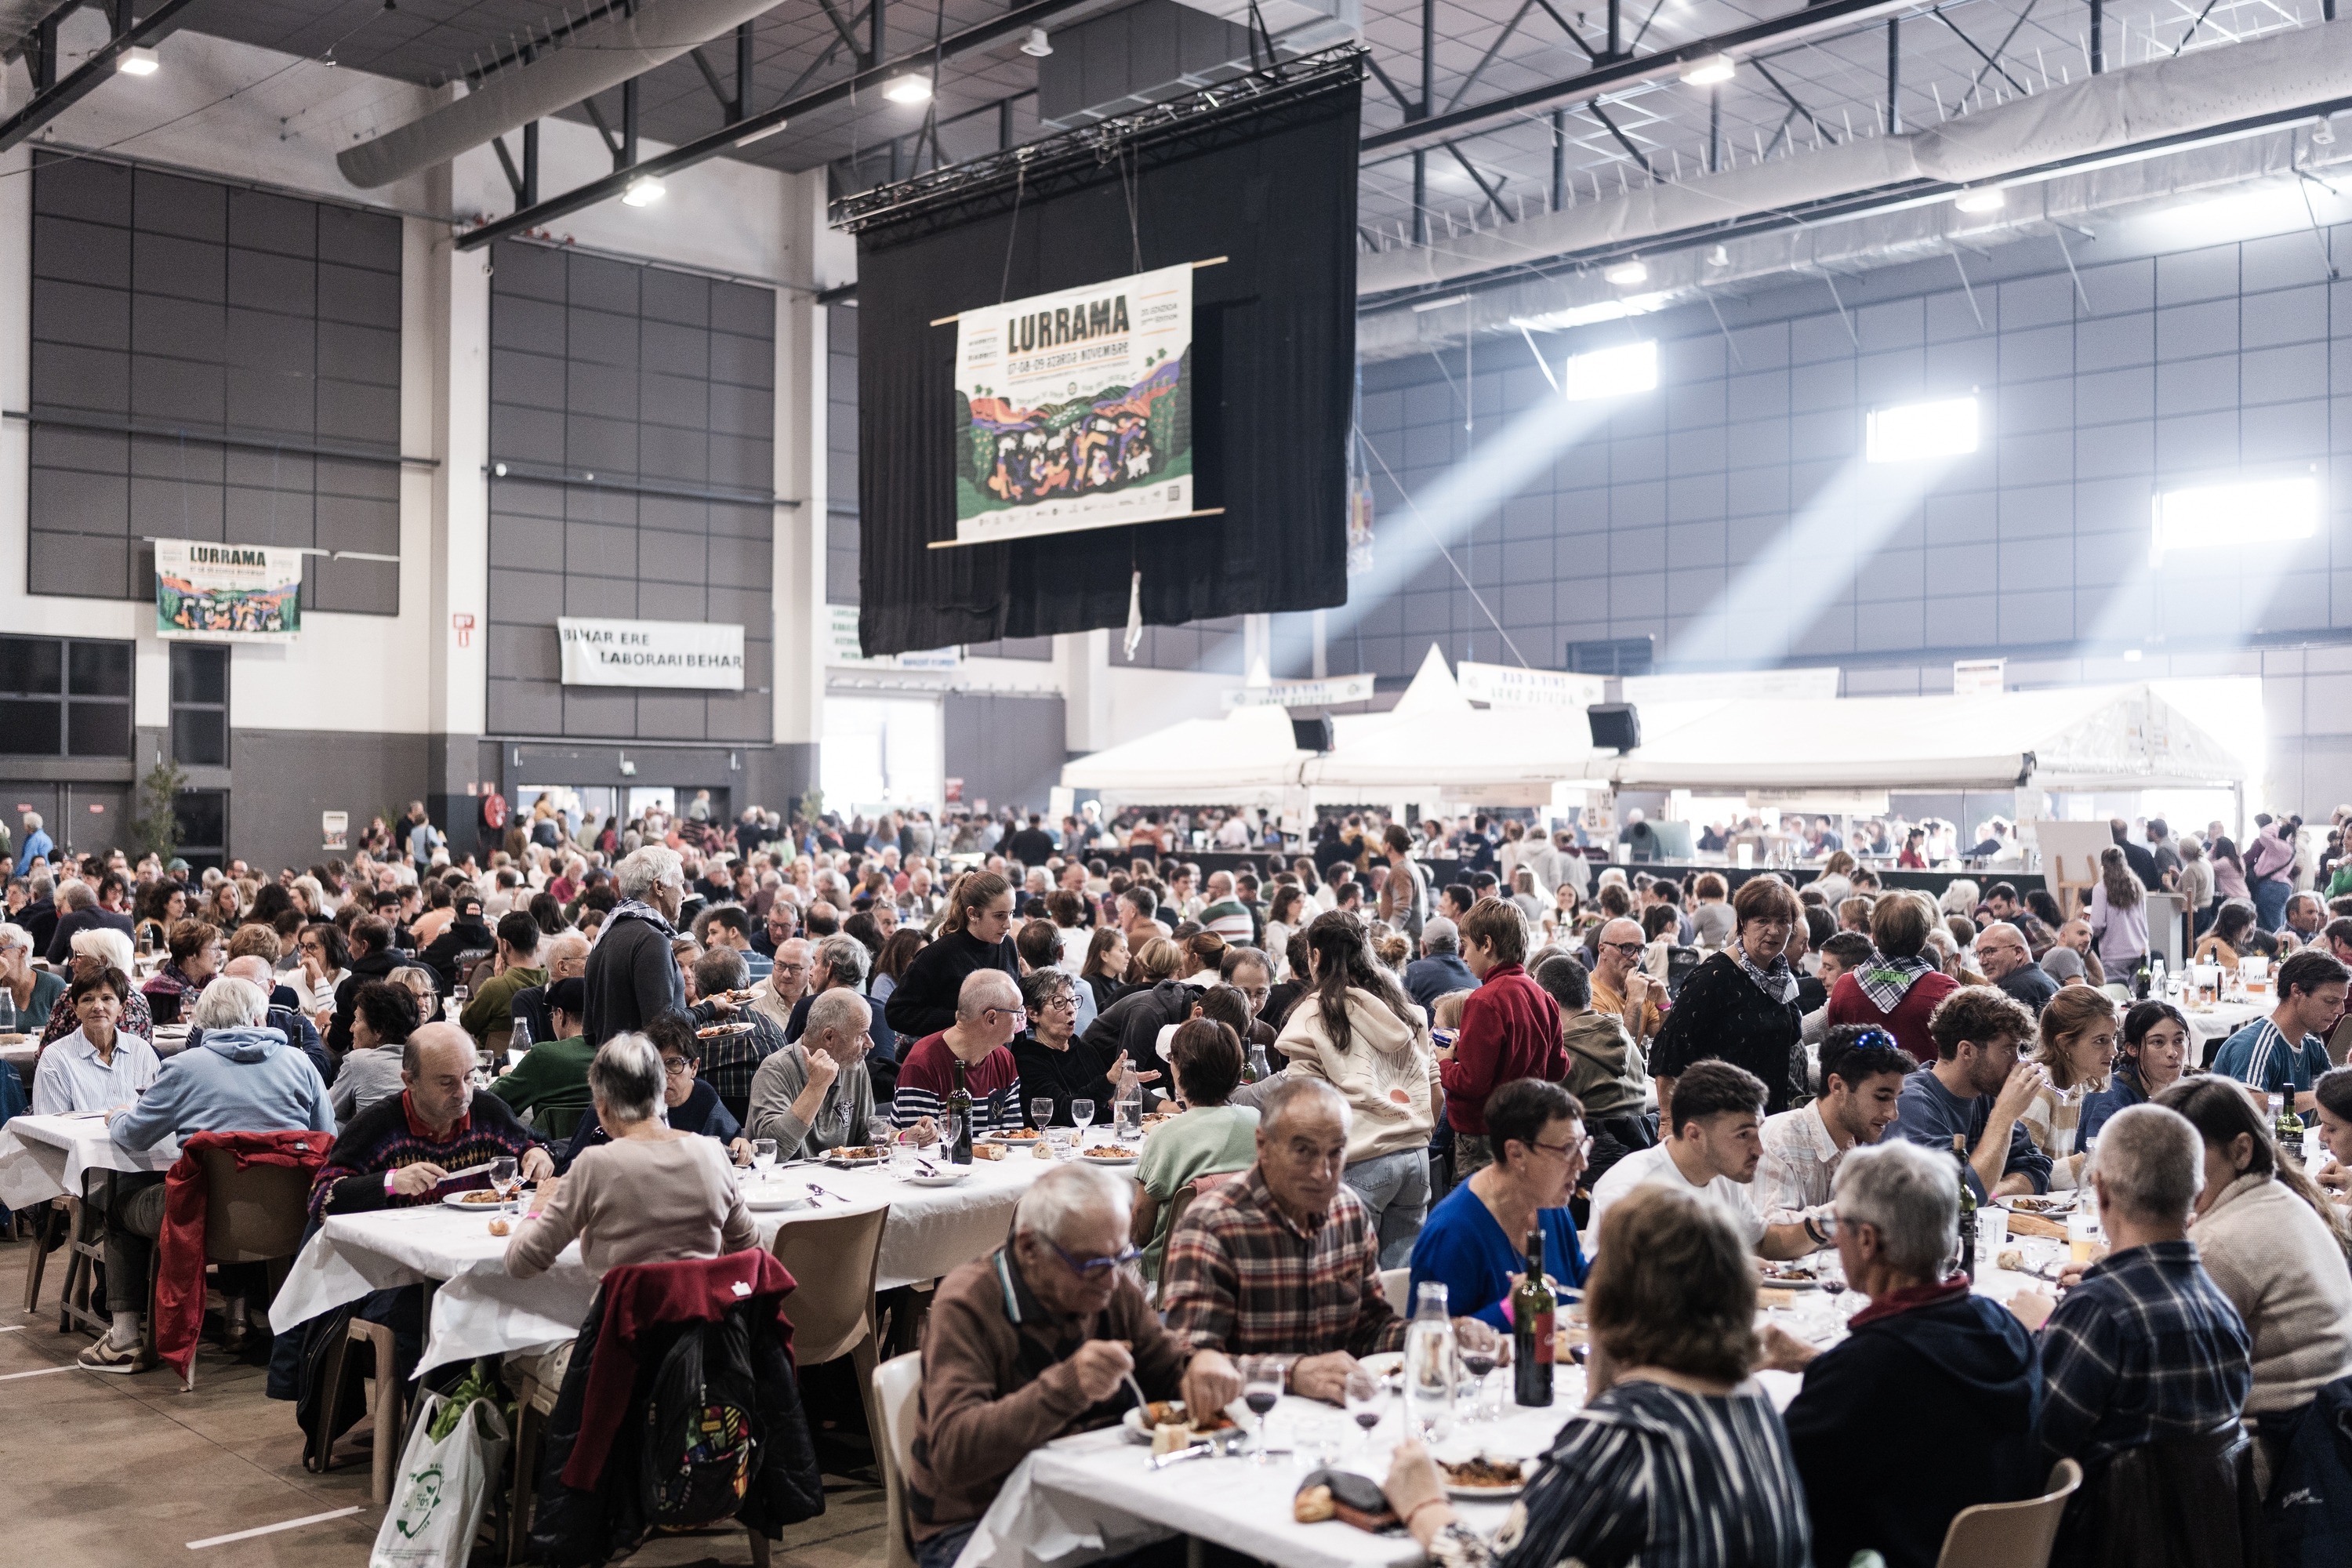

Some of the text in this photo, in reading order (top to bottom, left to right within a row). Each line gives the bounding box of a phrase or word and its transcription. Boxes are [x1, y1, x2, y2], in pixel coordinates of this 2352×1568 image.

[1009, 295, 1129, 354] LURRAMA
[1081, 342, 1129, 361] NOVEMBRE
[191, 546, 266, 566] LURRAMA
[564, 629, 650, 645] BIHAR ERE
[601, 652, 742, 669] LABORARI BEHAR
[1502, 672, 1523, 684] BAR
[1541, 674, 1566, 688] VINS
[1491, 688, 1521, 701] ARNO
